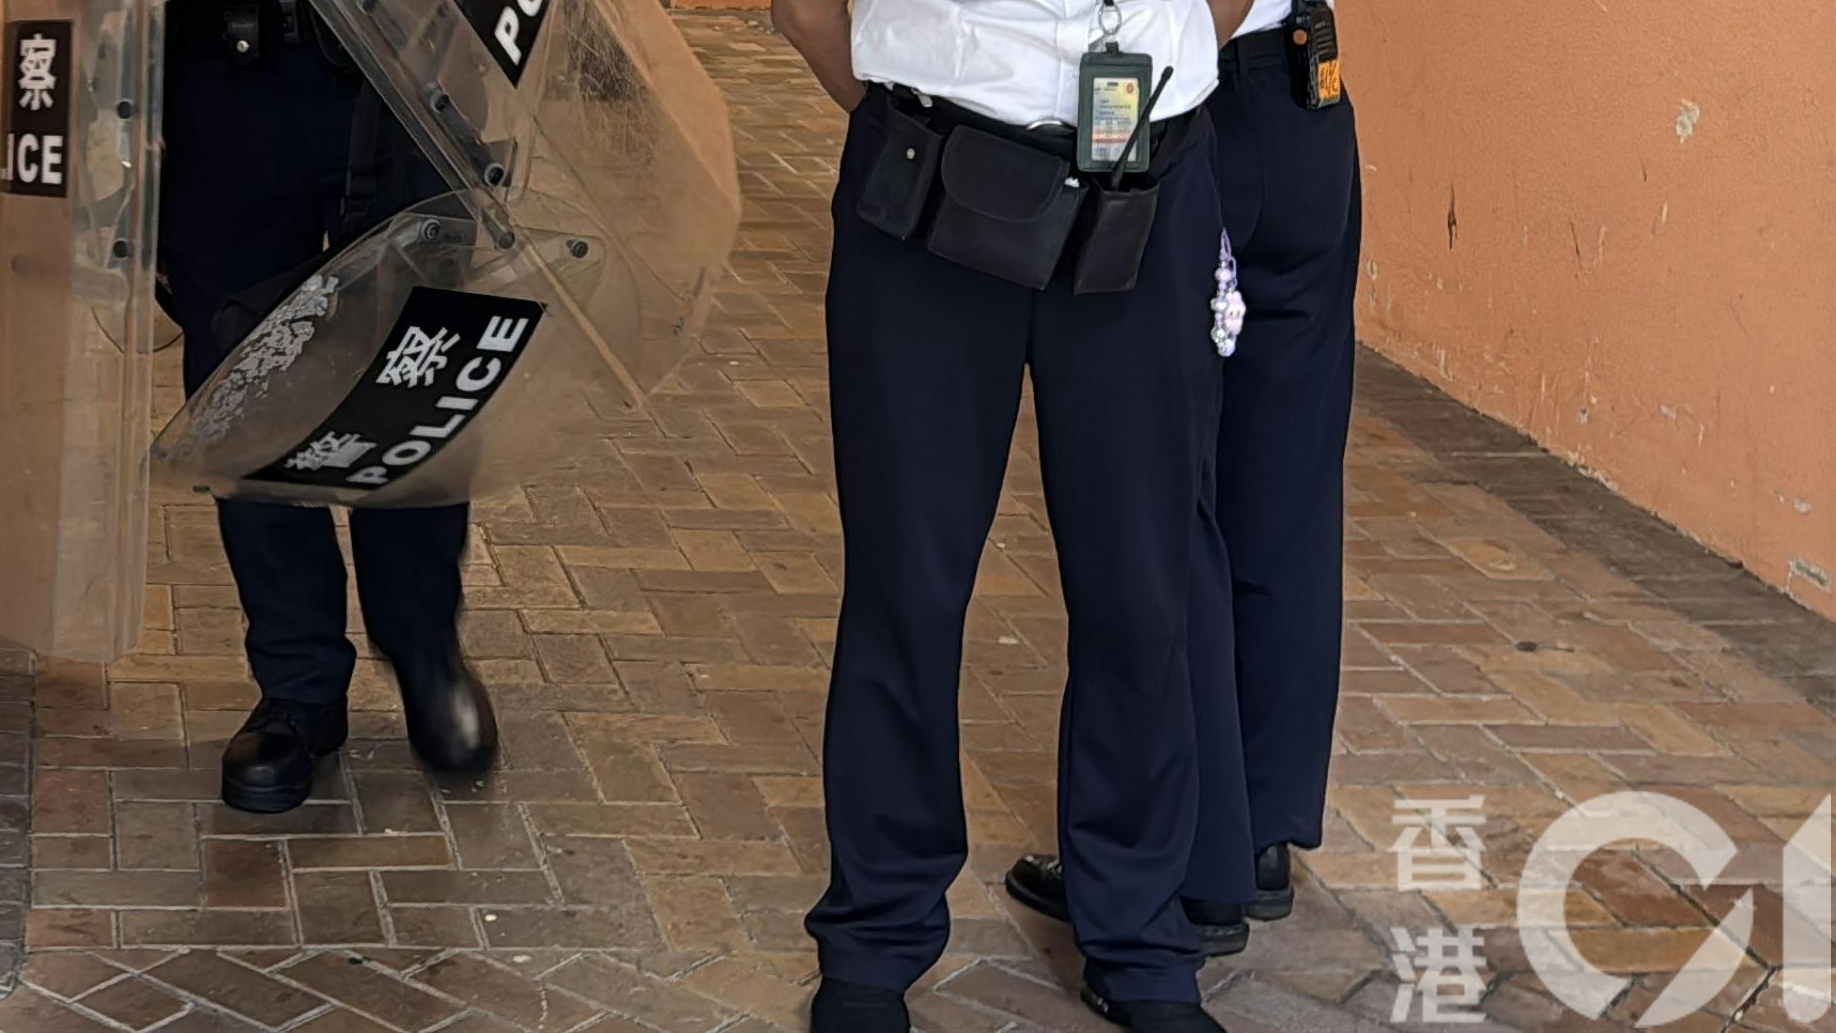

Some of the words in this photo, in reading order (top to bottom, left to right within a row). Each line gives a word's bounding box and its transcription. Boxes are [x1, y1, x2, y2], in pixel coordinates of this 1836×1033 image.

[18, 33, 58, 111] 察
[284, 326, 460, 471] 警察
[346, 315, 529, 485] POLICE
